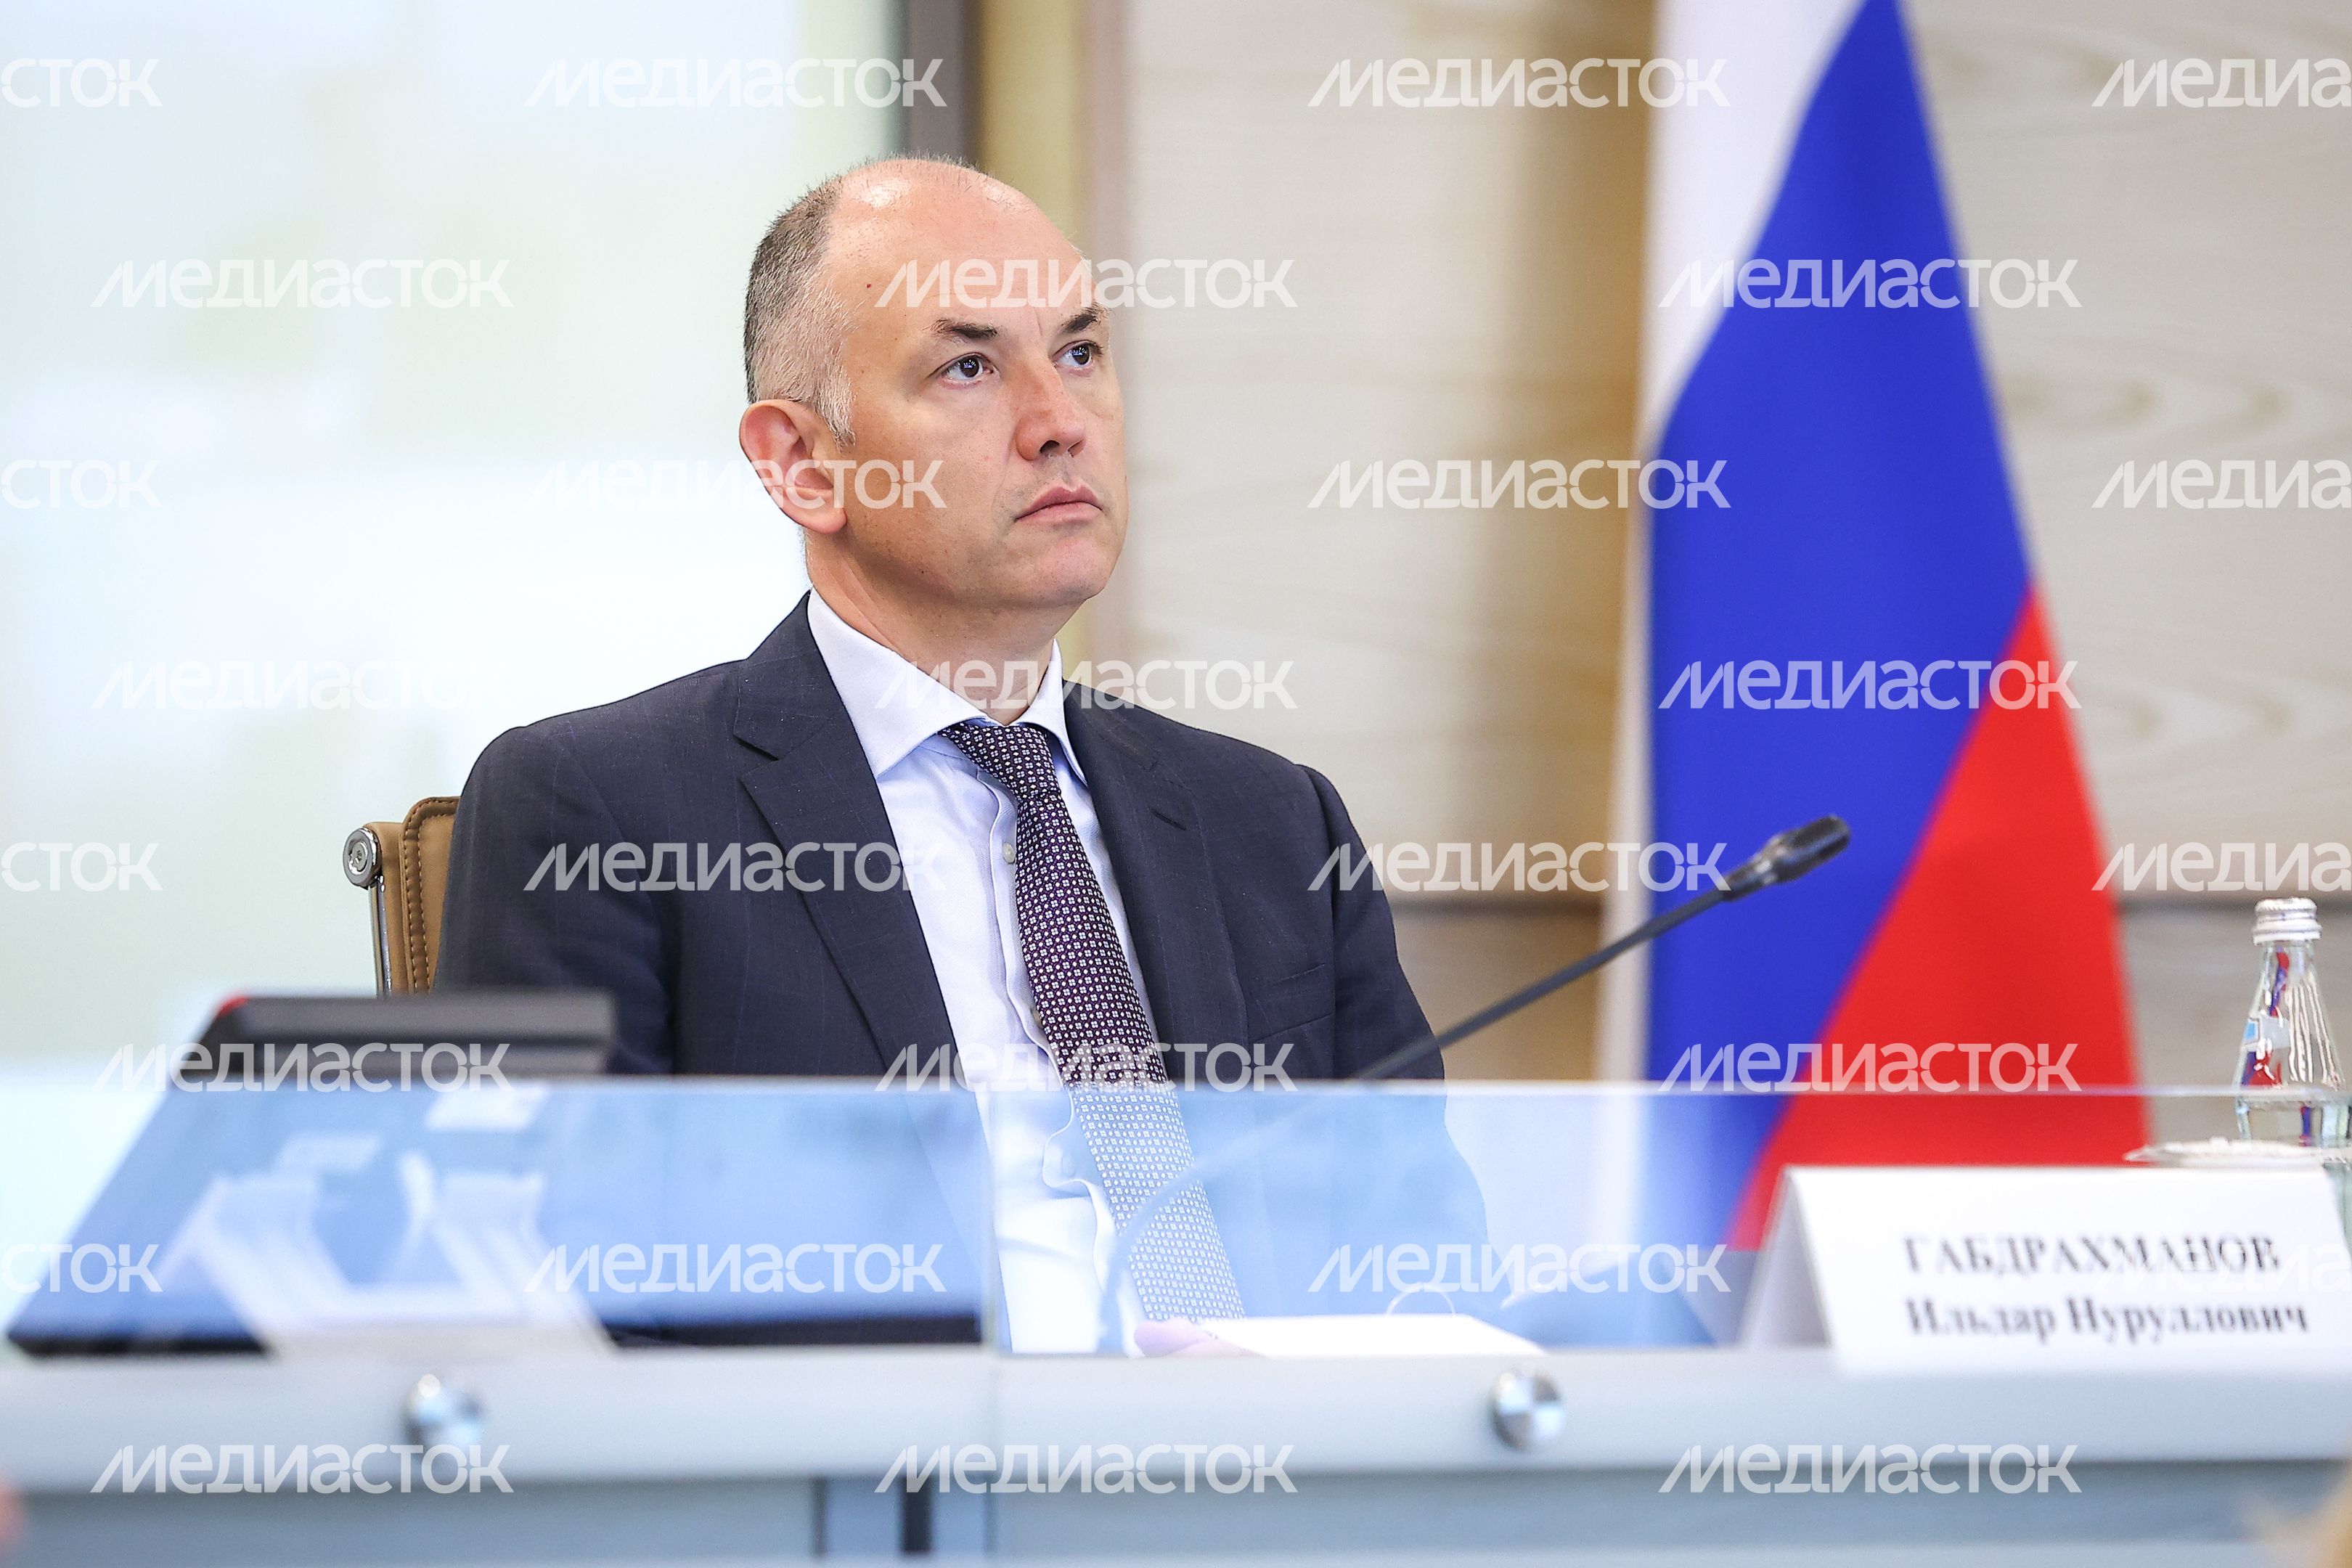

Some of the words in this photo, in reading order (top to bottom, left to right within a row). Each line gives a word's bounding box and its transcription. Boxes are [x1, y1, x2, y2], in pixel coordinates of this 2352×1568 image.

[1903, 1234, 2281, 1275] ГАБДРАХМАНОВ
[1905, 1297, 2057, 1345] Ильдар
[2066, 1296, 2310, 1345] Нуруллович
